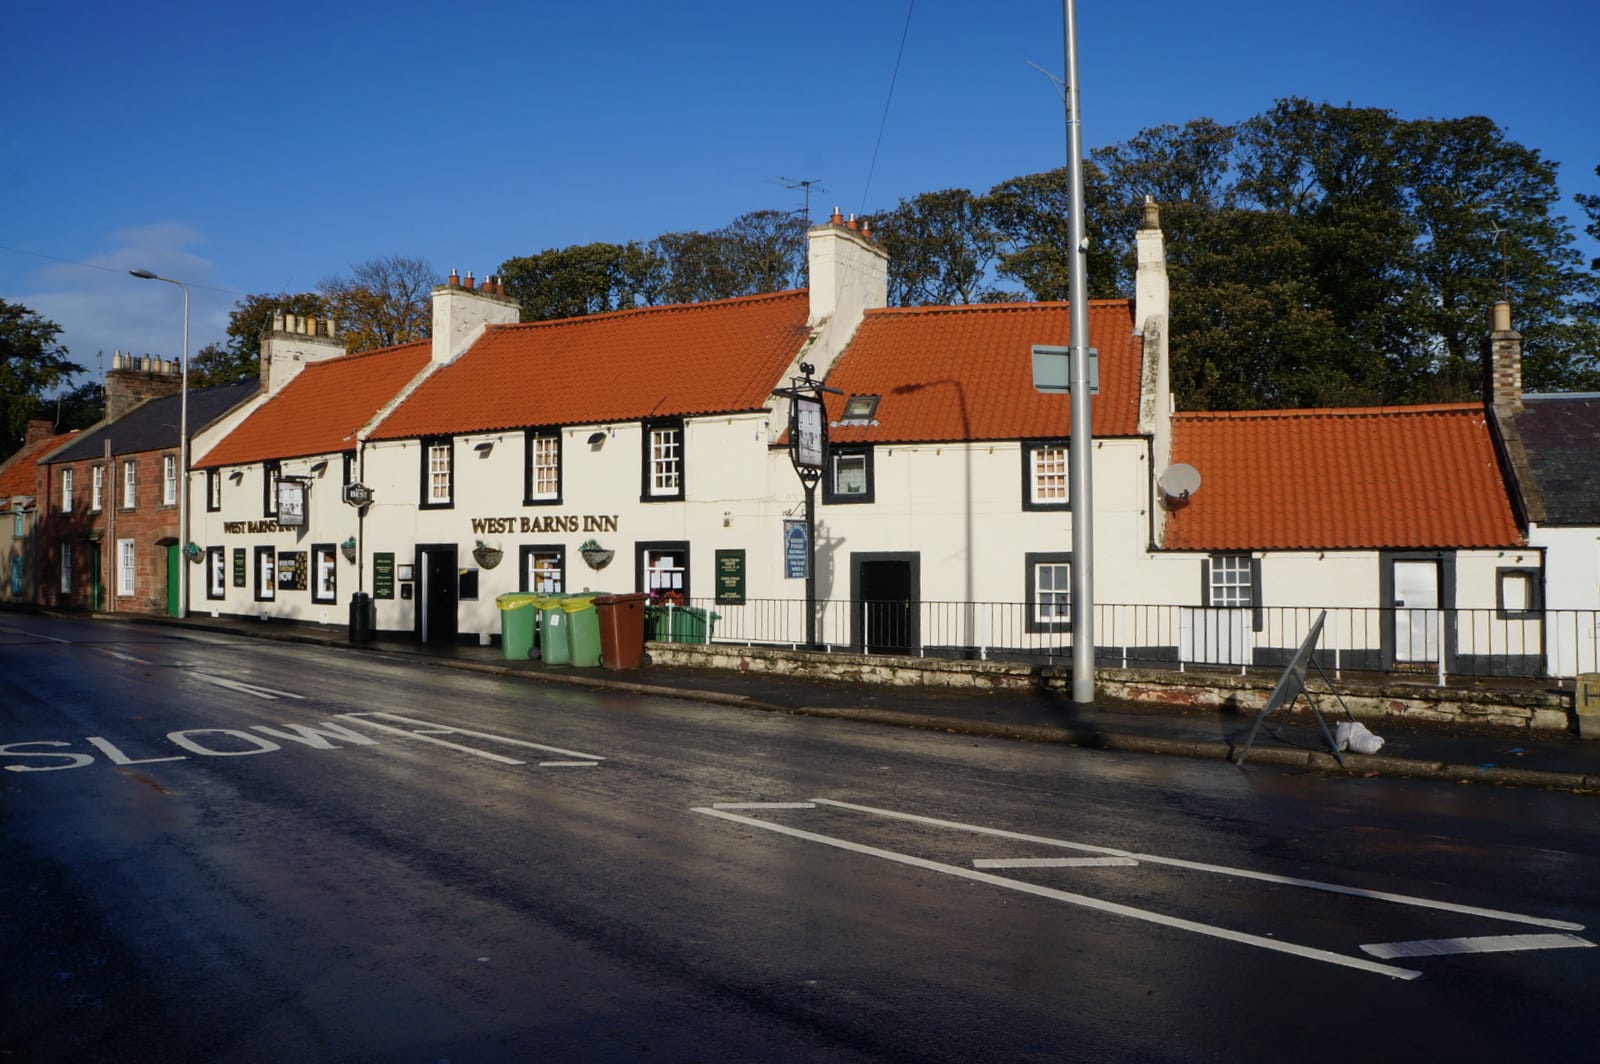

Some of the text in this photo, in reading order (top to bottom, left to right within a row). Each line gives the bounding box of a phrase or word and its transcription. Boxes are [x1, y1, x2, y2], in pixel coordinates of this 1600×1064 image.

[224, 521, 246, 534] WEST
[247, 520, 278, 533] BARNS
[471, 515, 619, 534] WEST BARNS INN
[0, 721, 380, 772] SLOW
